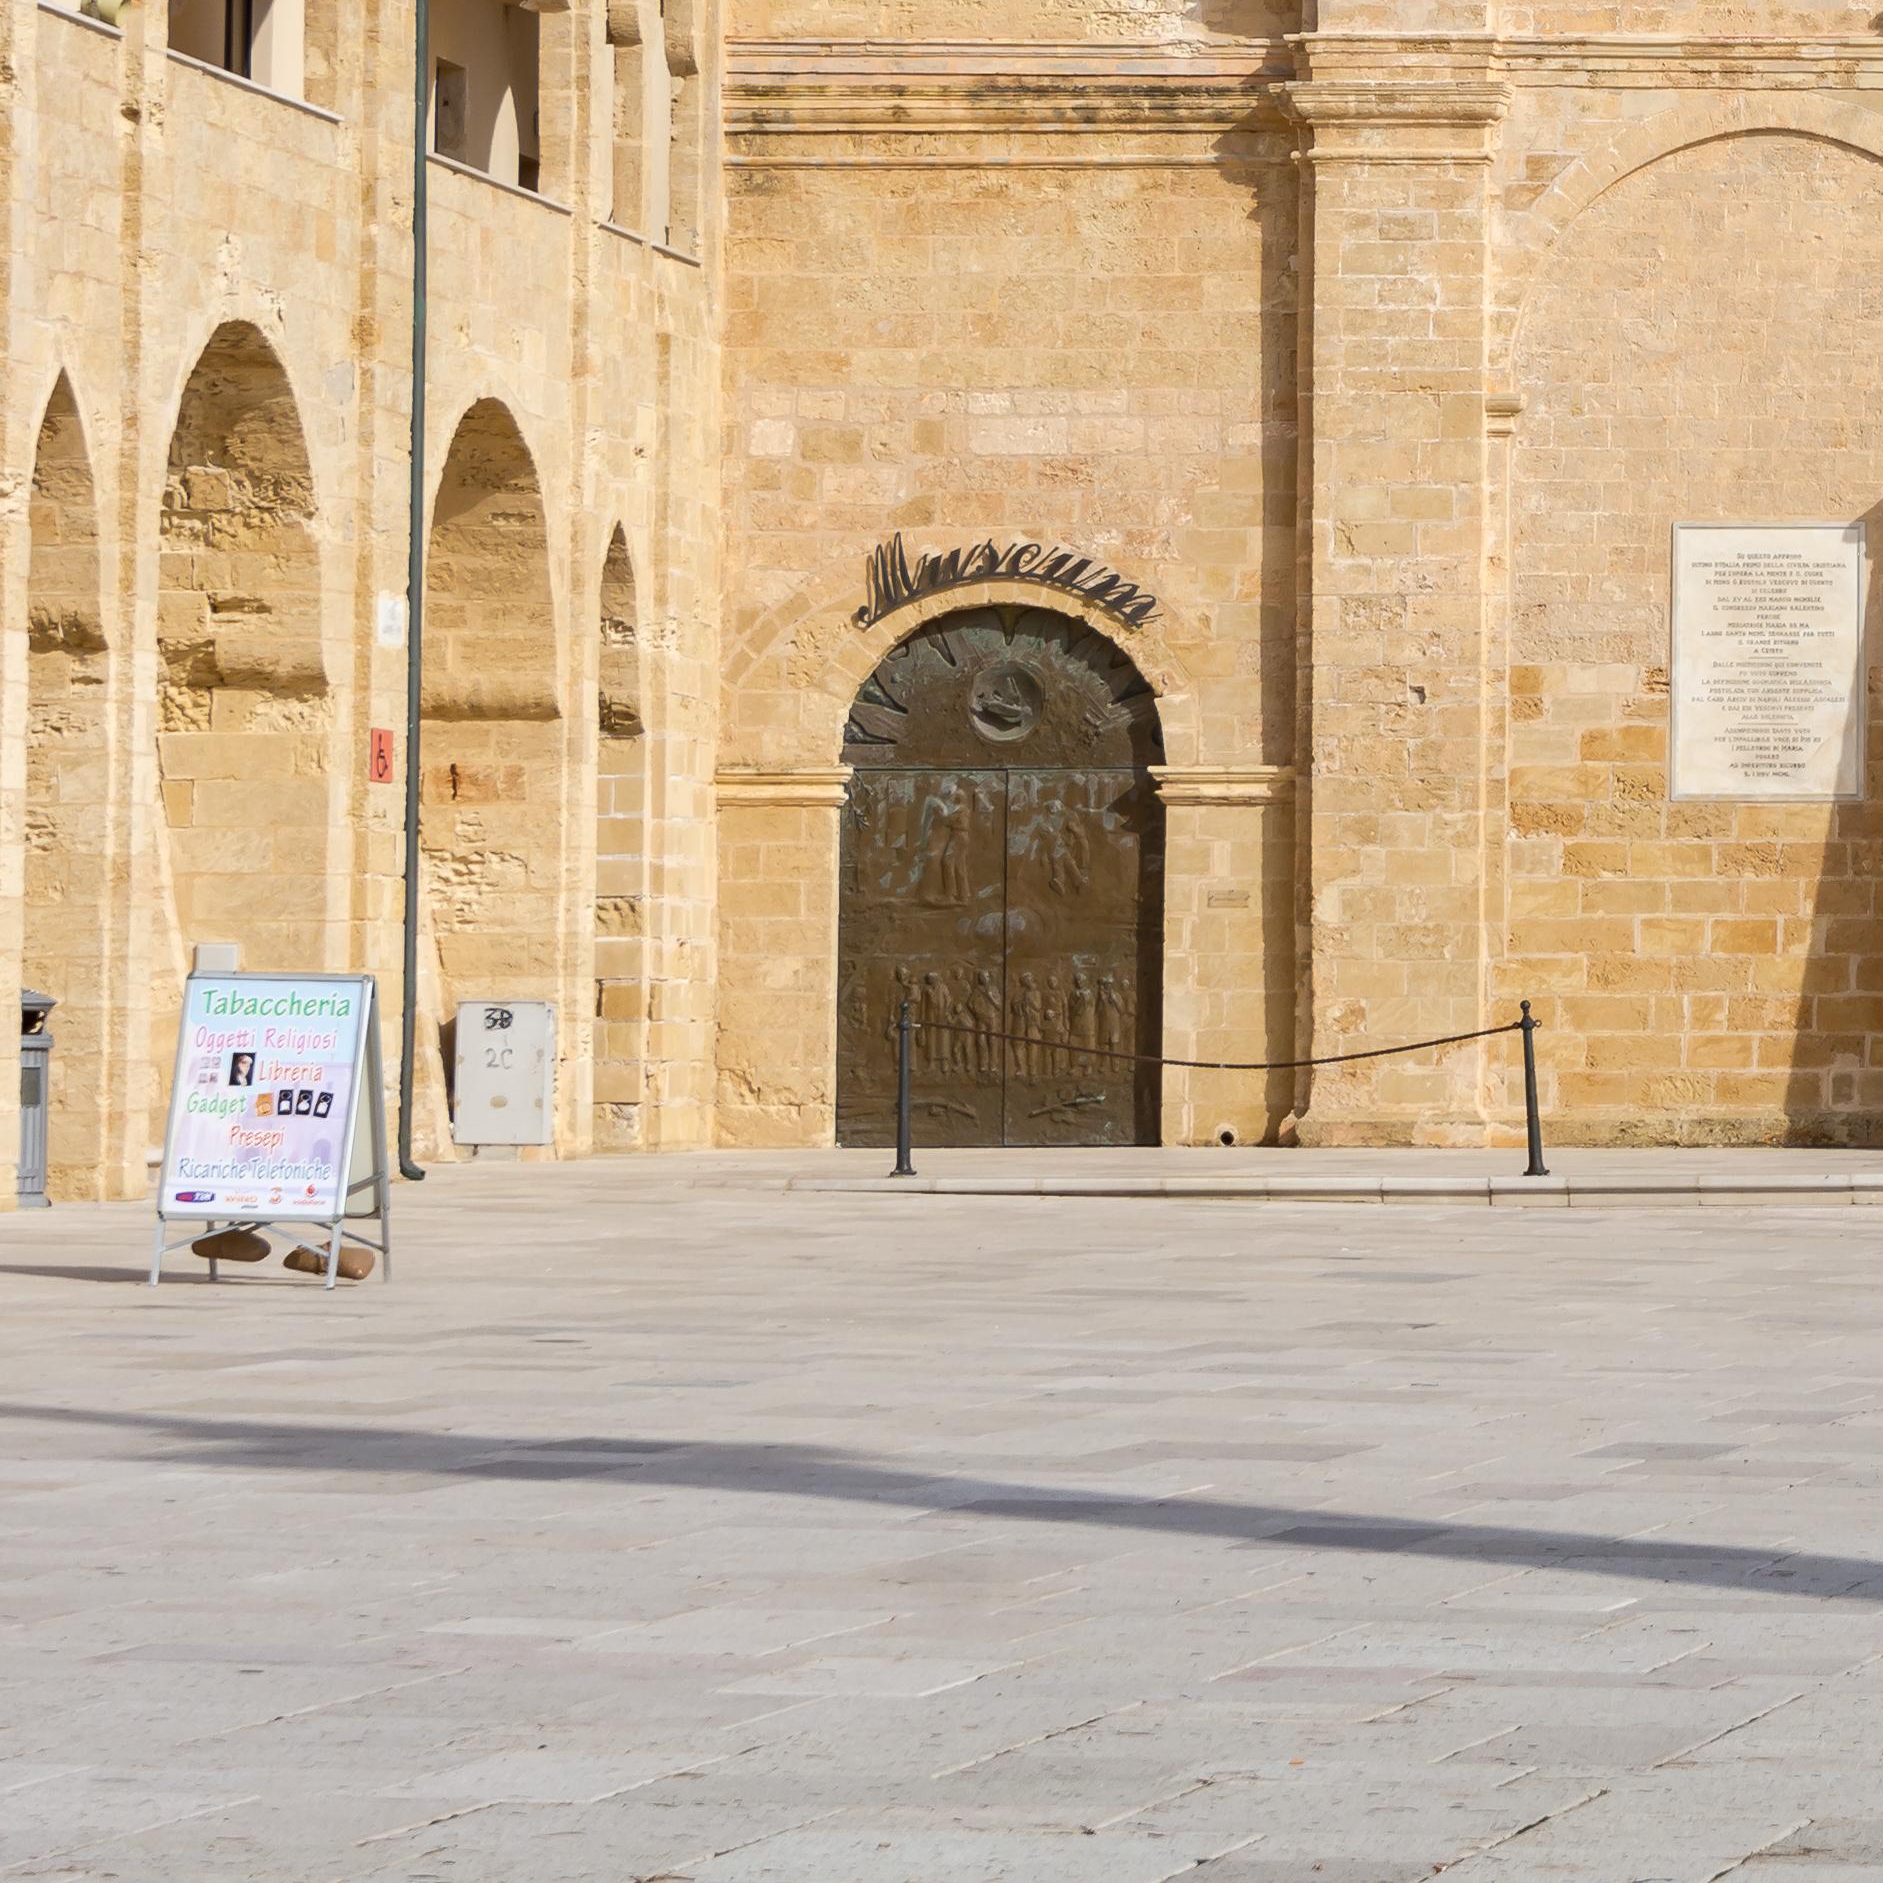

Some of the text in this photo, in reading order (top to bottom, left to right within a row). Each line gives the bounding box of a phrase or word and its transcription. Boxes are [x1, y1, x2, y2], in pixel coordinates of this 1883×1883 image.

[852, 530, 1165, 629] Museum
[203, 990, 350, 1017] Tabaccheria
[196, 1026, 337, 1054] Oggetti Religiosi
[258, 1060, 323, 1082] Libreria
[186, 1091, 247, 1119] Gadget
[229, 1126, 286, 1151] Presepi
[177, 1157, 332, 1180] Ricariche Telefoniche
